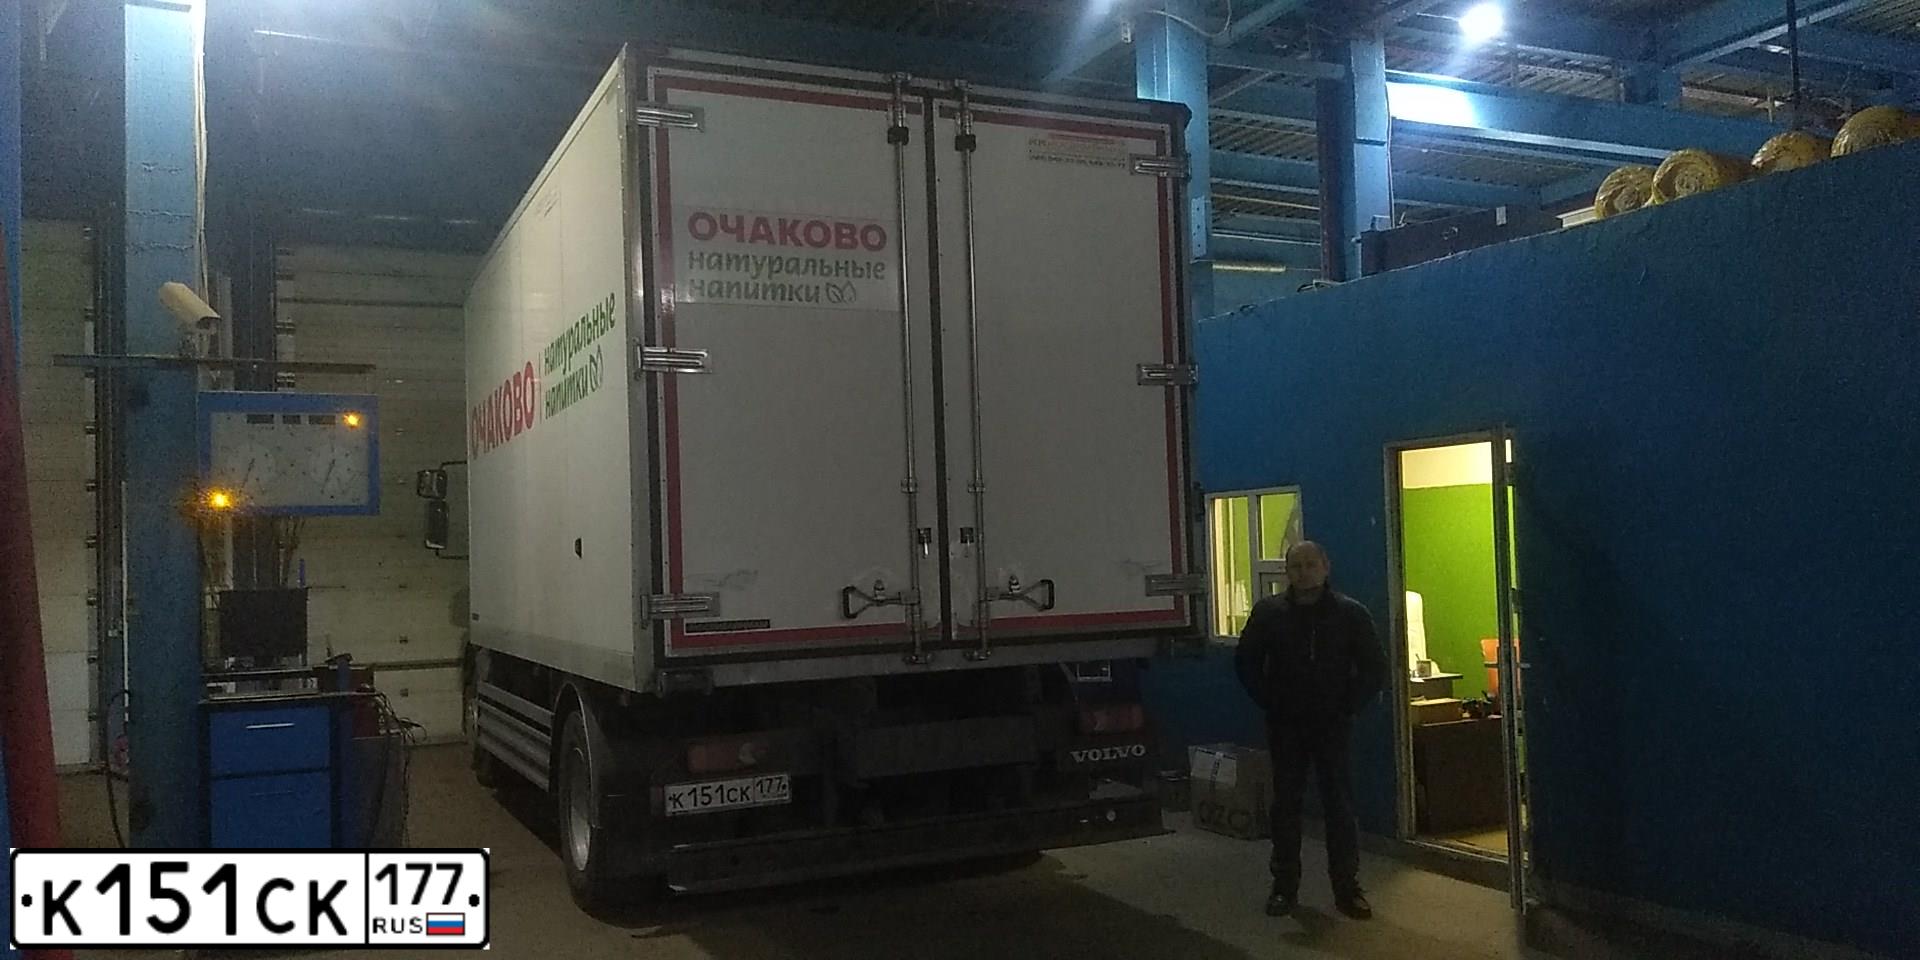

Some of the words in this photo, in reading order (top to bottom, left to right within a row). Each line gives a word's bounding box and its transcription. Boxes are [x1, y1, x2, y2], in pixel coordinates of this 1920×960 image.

[687, 211, 887, 252] ОЧАКОВО
[688, 250, 886, 280] натуральные
[688, 278, 820, 304] напитки
[544, 292, 616, 376] натуральные
[545, 364, 589, 420] напитки
[470, 361, 536, 461] ОЧАКОВО
[1070, 744, 1146, 763] VOLVO
[672, 784, 751, 809] К151СК
[756, 777, 783, 794] 177
